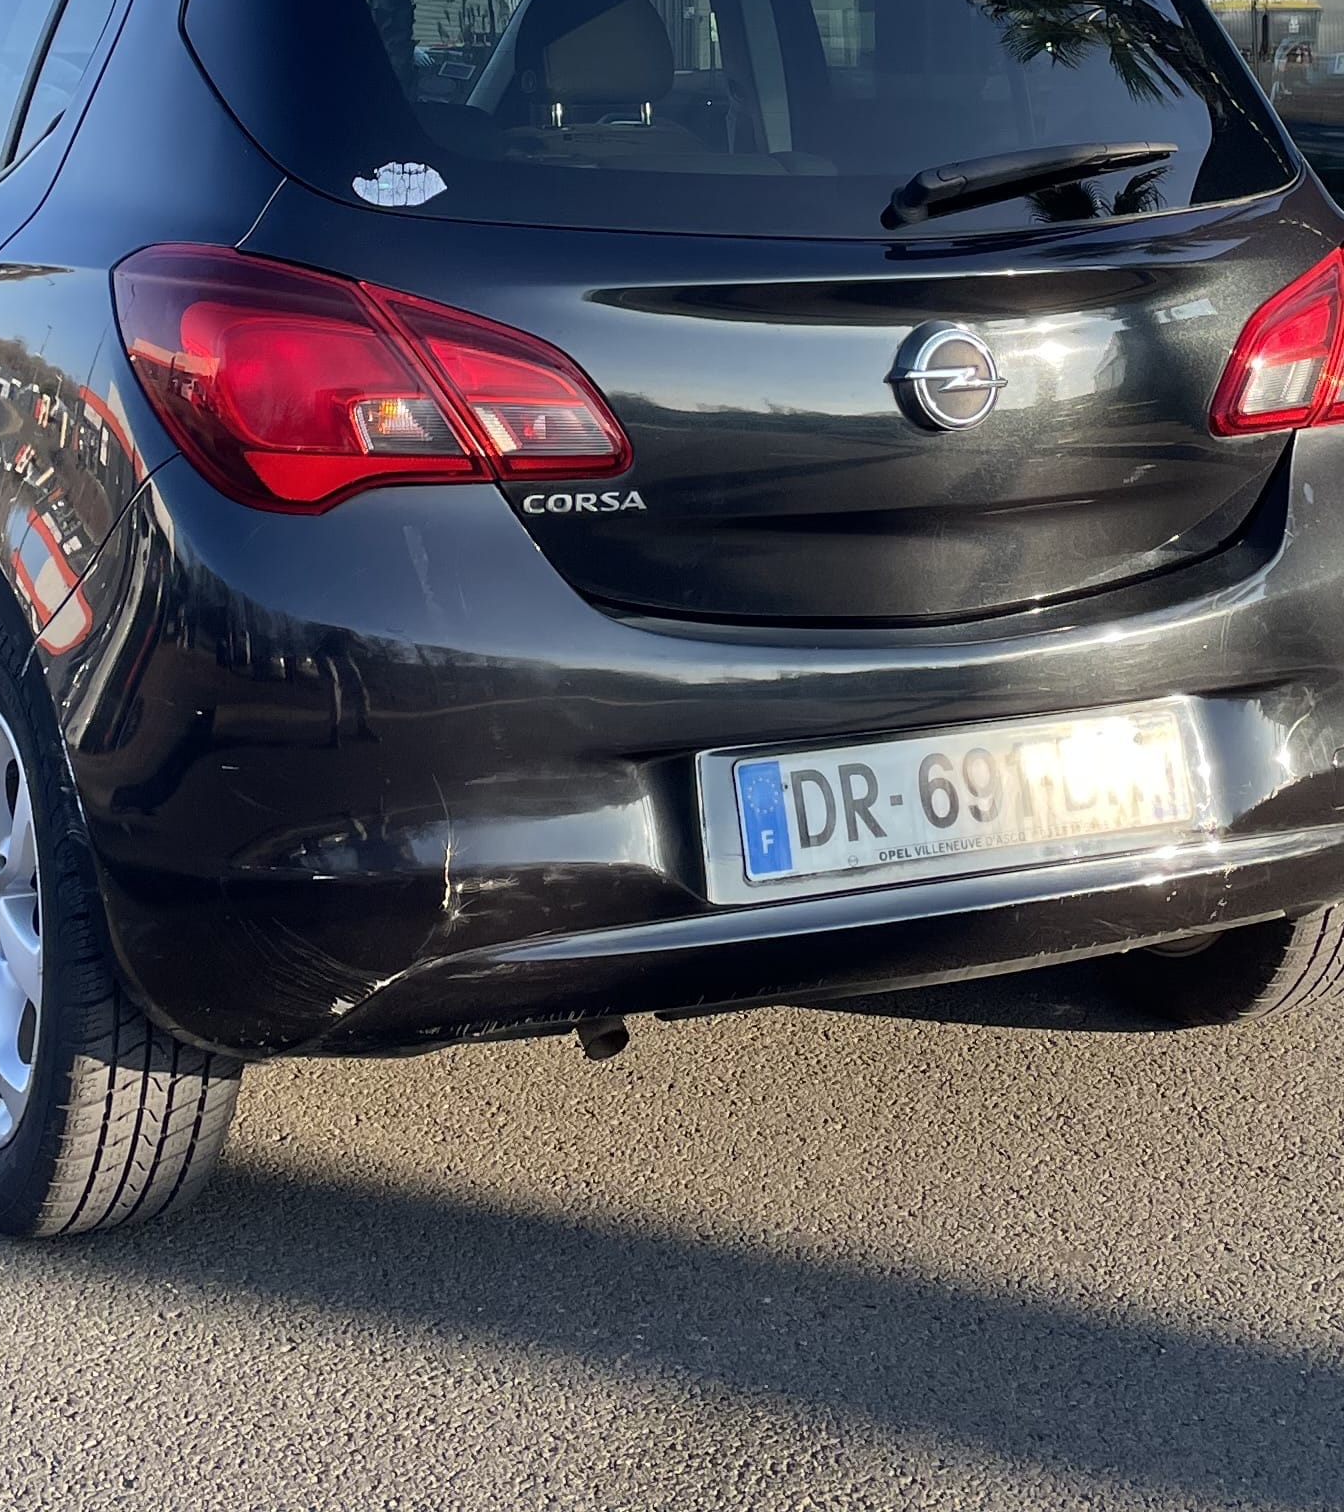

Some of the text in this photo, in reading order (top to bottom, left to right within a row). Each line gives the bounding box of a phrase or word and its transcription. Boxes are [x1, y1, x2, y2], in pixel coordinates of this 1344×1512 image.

[522, 490, 648, 514] CORSA
[760, 828, 776, 855] F
[878, 847, 913, 862] OPEL
[914, 837, 984, 860] VILLENEUVE
